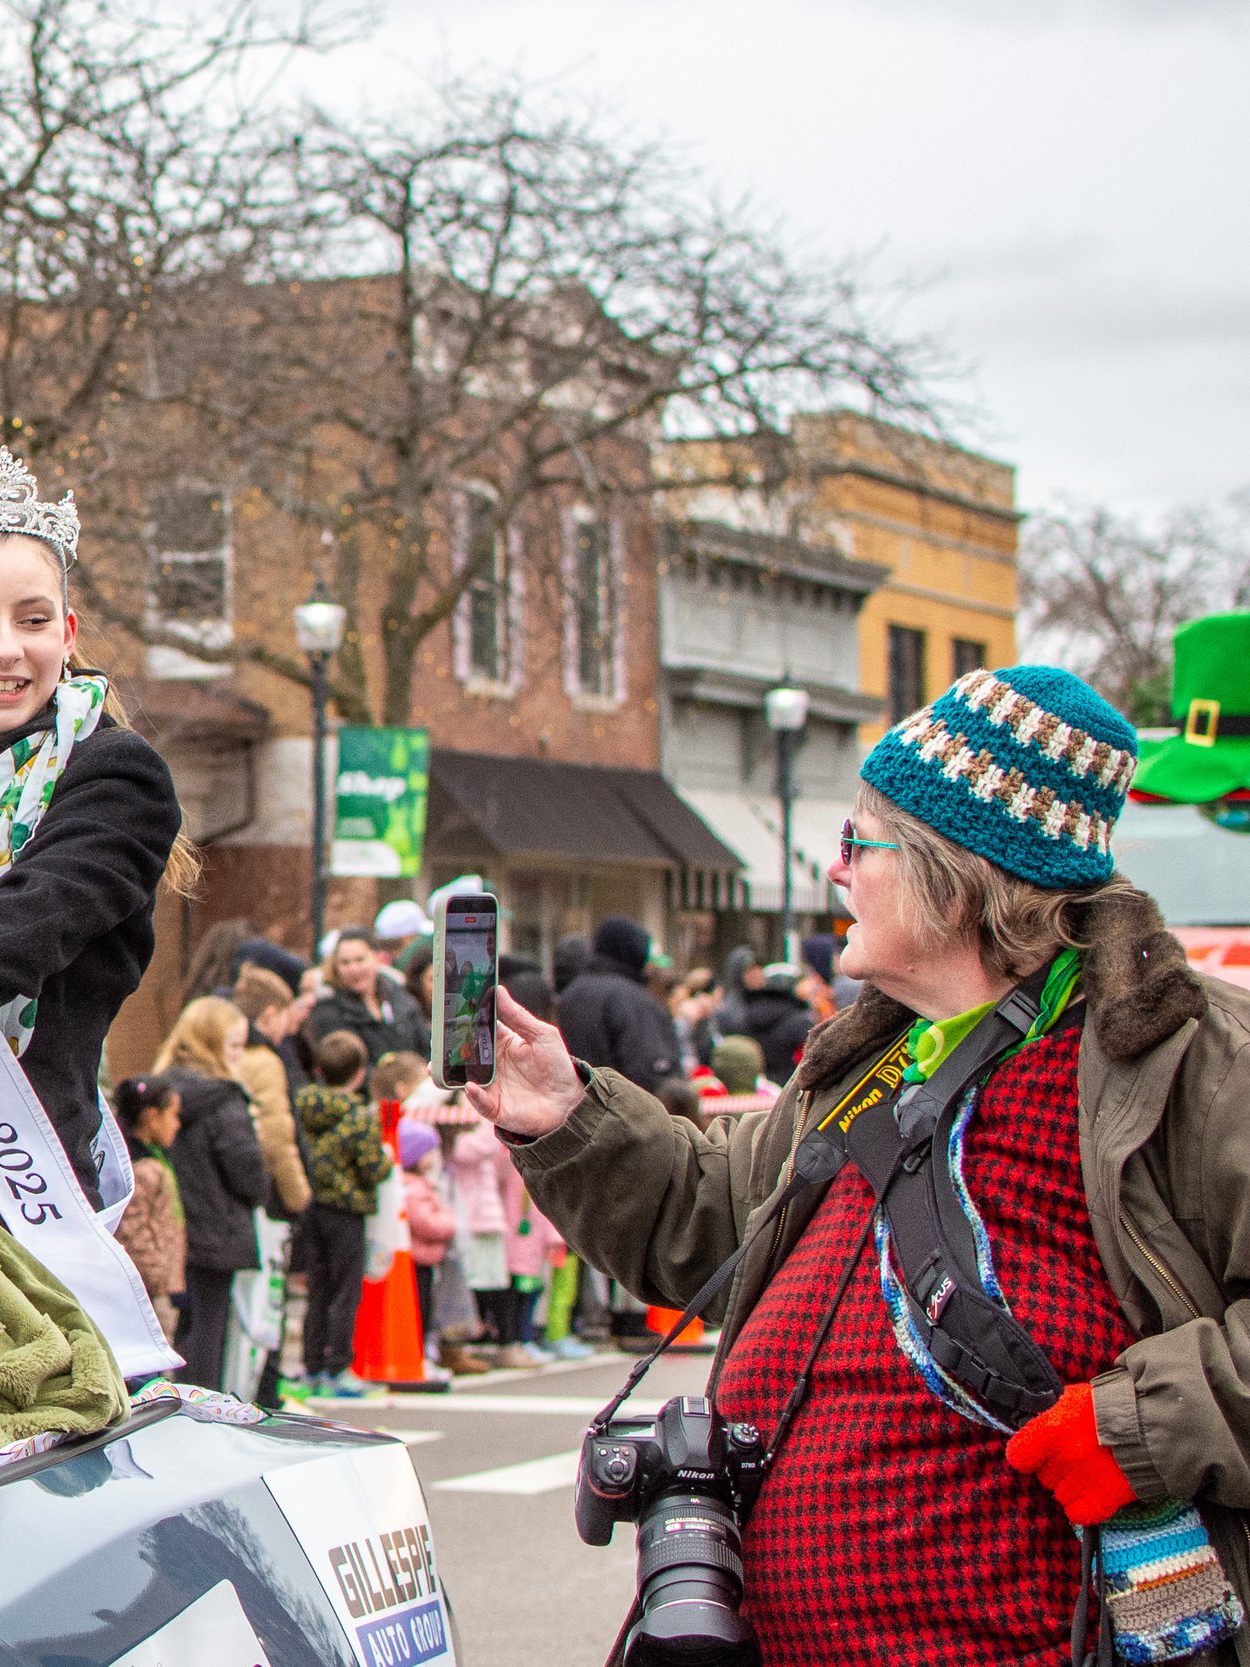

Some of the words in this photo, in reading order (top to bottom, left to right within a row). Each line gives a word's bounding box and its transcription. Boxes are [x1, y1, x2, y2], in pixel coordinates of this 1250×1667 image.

[677, 1469, 715, 1480] Nikon
[328, 1524, 437, 1619] GILLESPIE
[367, 1622, 410, 1667] AUTO
[410, 1610, 444, 1654] GROUP
